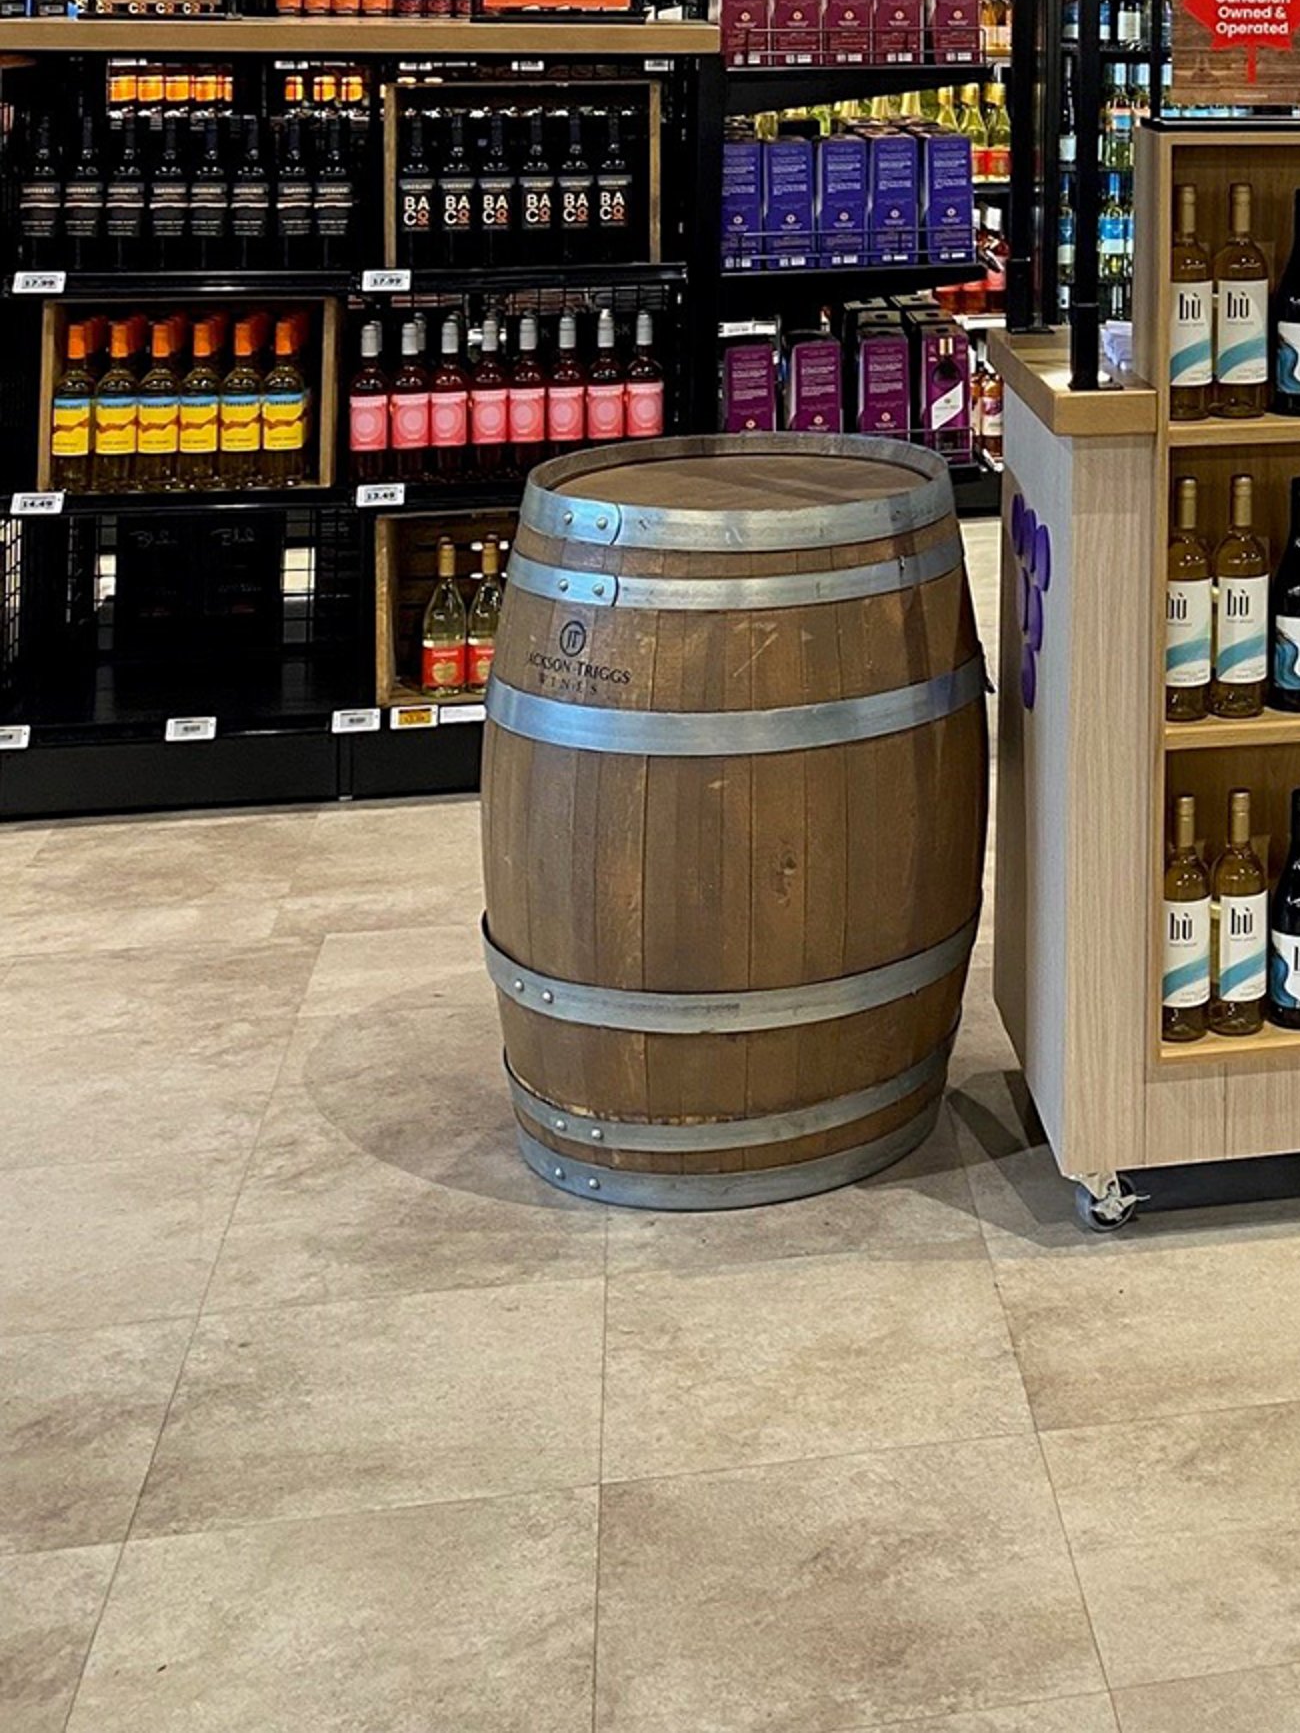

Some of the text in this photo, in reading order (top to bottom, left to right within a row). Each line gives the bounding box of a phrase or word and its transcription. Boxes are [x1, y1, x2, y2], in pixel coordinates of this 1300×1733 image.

[1218, 5, 1287, 19] Owned &
[1216, 22, 1289, 37] Operated
[1179, 291, 1201, 320] bù
[1226, 291, 1250, 319] bù
[1226, 587, 1250, 617] bù
[1169, 912, 1193, 940] bù
[1231, 906, 1253, 935] bù
